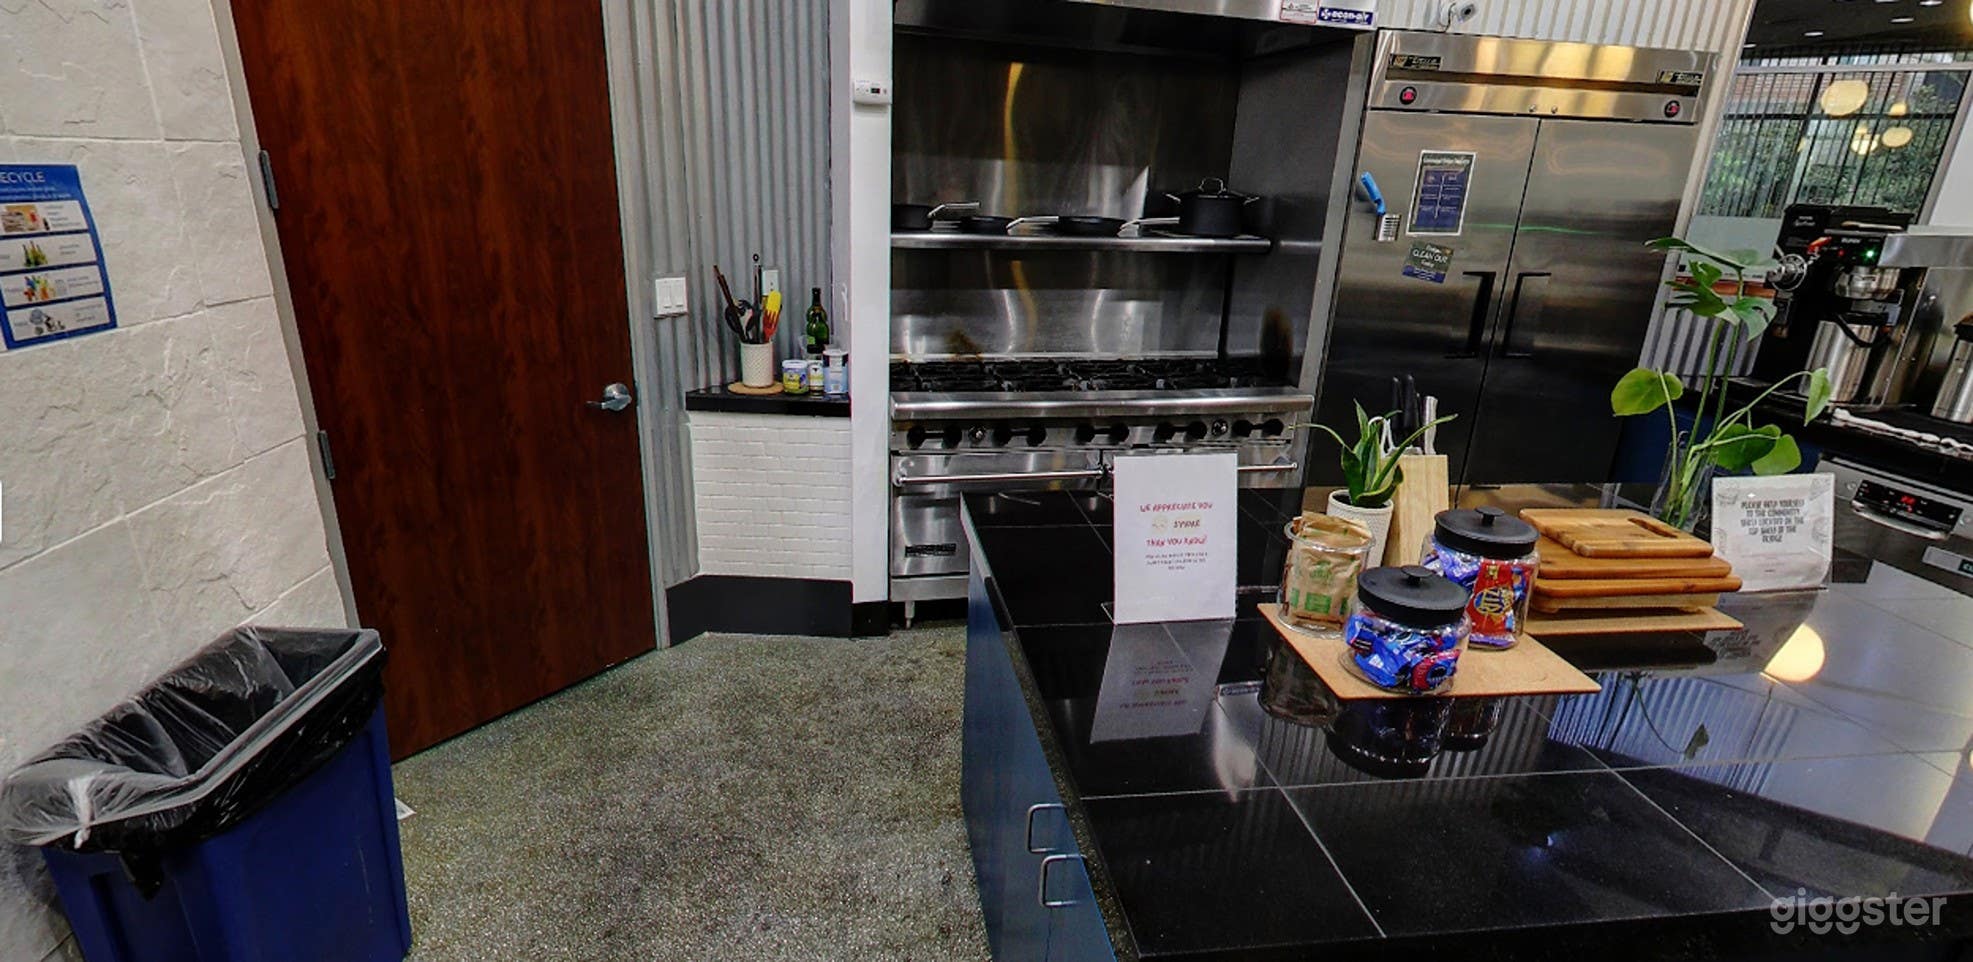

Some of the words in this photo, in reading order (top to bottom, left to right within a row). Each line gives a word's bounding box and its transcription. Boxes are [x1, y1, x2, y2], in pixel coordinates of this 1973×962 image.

[0, 171, 45, 184] ECYCLE
[1412, 249, 1434, 260] CLEAN
[1167, 537, 1182, 546] YOU
